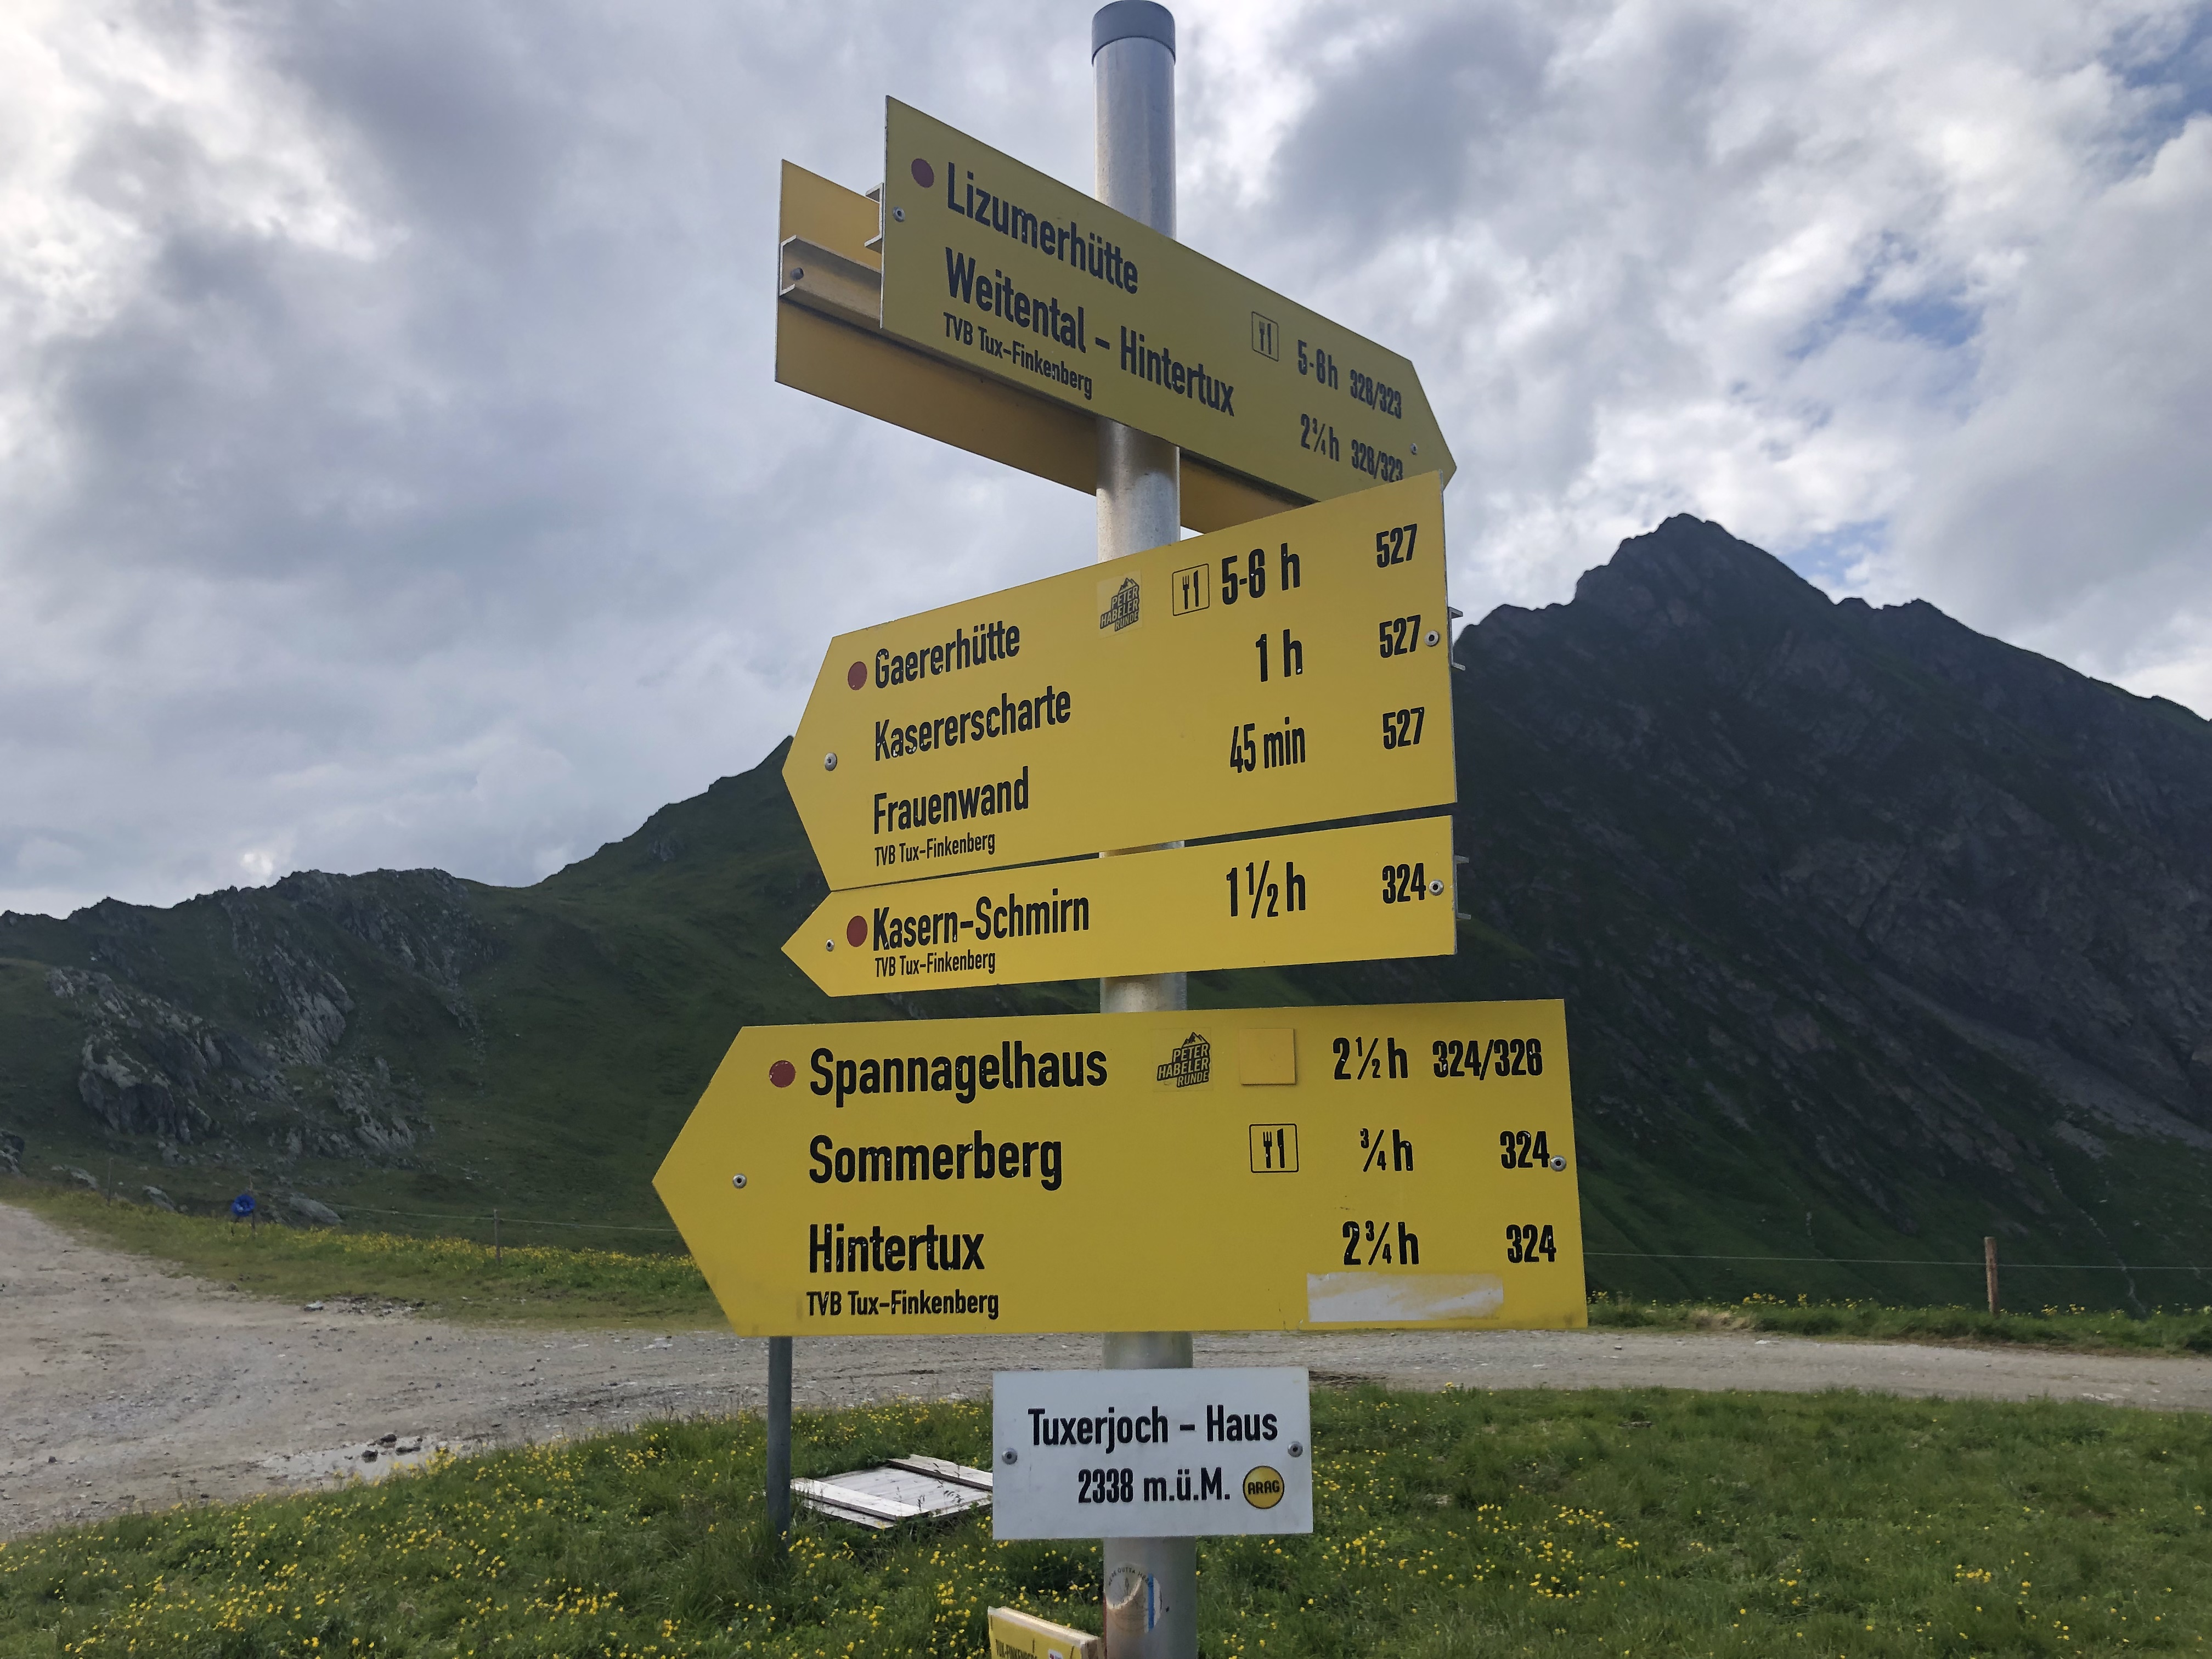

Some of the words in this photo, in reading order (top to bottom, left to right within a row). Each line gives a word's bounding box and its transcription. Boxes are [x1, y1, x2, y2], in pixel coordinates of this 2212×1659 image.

[947, 162, 1138, 294] Lizumerhütte
[945, 247, 1086, 354] Weitental
[1120, 325, 1234, 417] Hintertux
[943, 312, 973, 346] TVB
[978, 326, 1092, 400] Tux-Finkenberg
[875, 621, 1020, 689] Gaererhütte
[1376, 524, 1418, 568] 527
[1101, 598, 1139, 628] HABELER
[1111, 586, 1138, 610] PETER
[1115, 611, 1139, 630] RUNDE
[875, 685, 1071, 761] Kasererscharte
[1380, 615, 1421, 658] 527
[874, 766, 1029, 834] Frauenwand
[1383, 707, 1425, 750] 527
[875, 845, 896, 867] TVB
[899, 832, 995, 864] Tux-Finkenberg
[873, 888, 1089, 951] Kasern-Schmirn
[1383, 863, 1426, 904] 324
[875, 957, 896, 978] TVB
[900, 950, 996, 975] Tux-Finkenberg
[810, 1040, 1108, 1108] Spannagelhaus
[1432, 1039, 1543, 1081] 324/326
[1158, 1057, 1209, 1080] HABELER
[1173, 1044, 1208, 1063] PETER
[1177, 1070, 1209, 1087] RUNDE
[809, 1130, 1062, 1191] Sommerberg
[1500, 1131, 1550, 1169] 324
[809, 1223, 985, 1273] Hintertux
[1506, 1224, 1557, 1263] 324
[806, 1291, 842, 1316] TVB
[848, 1289, 999, 1320] Tux-Finkenberg
[1028, 1406, 1169, 1454] Tuxerjoch
[1206, 1404, 1278, 1442] Haus
[1078, 1468, 1133, 1504] 2338
[1143, 1468, 1231, 1502] m.ü.M.
[1247, 1480, 1280, 1496] ARAG
